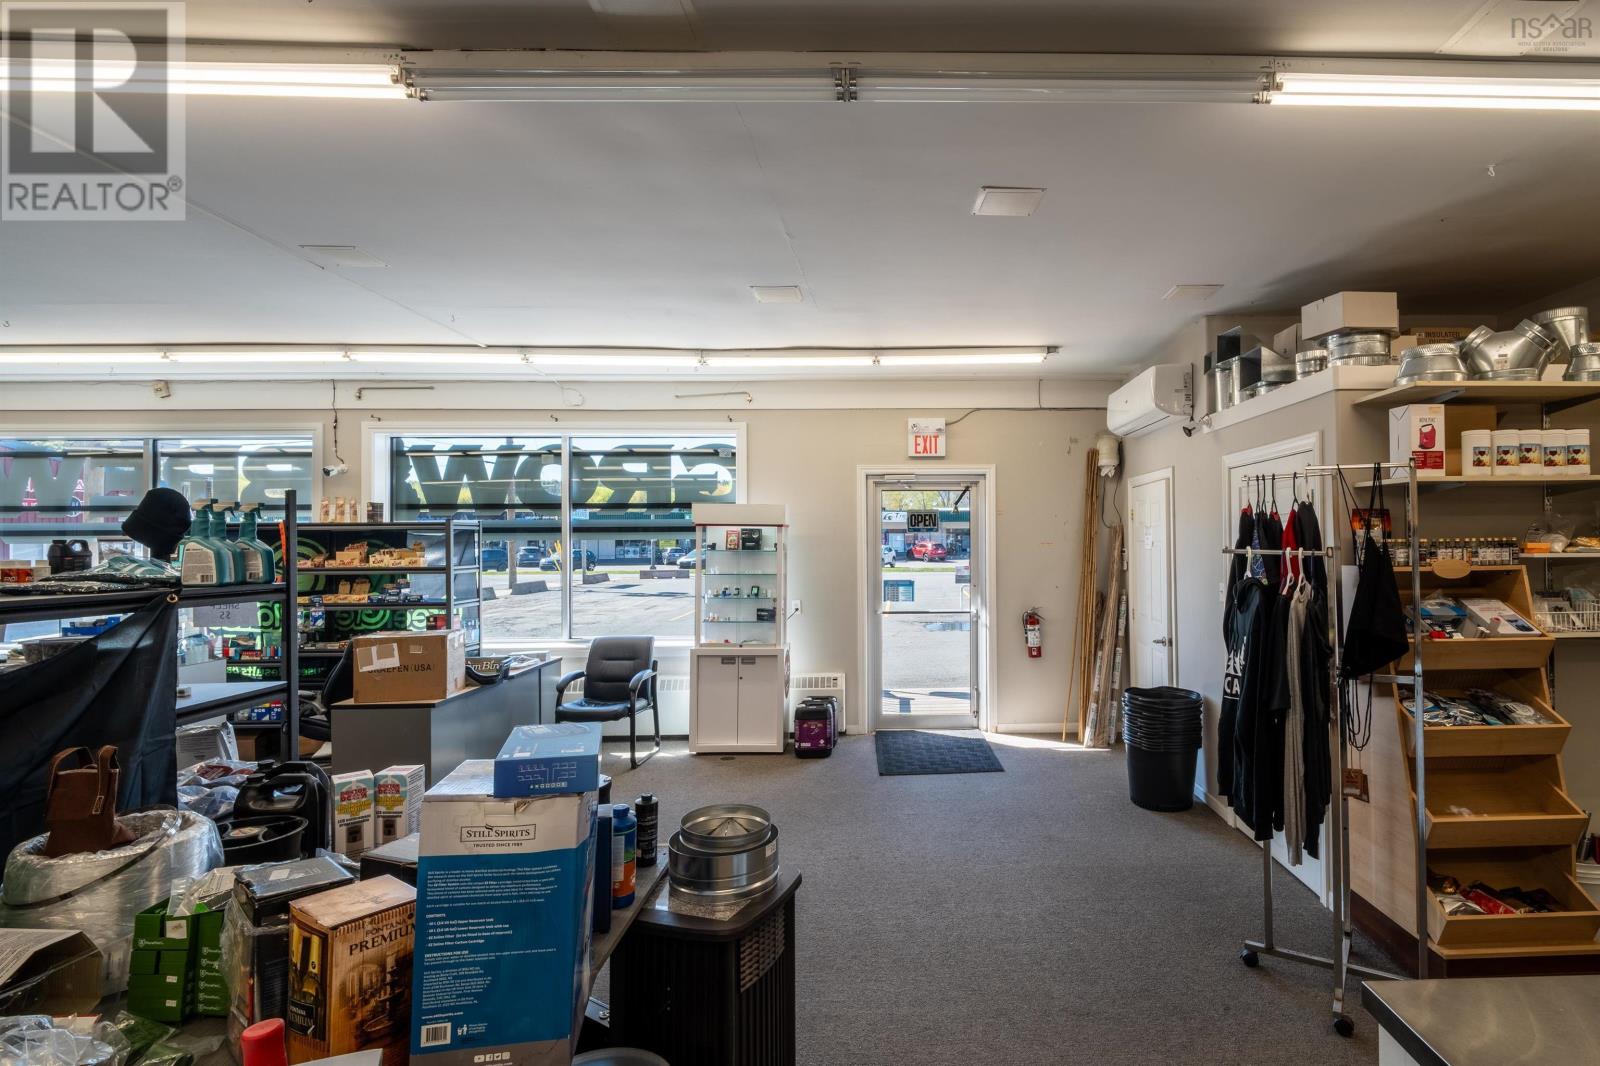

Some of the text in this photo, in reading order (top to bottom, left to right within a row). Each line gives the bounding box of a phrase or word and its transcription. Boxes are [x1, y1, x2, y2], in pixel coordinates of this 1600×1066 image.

[914, 435, 939, 454] EXIT
[910, 513, 937, 528] OPEN
[494, 829, 530, 838] SPIRITS
